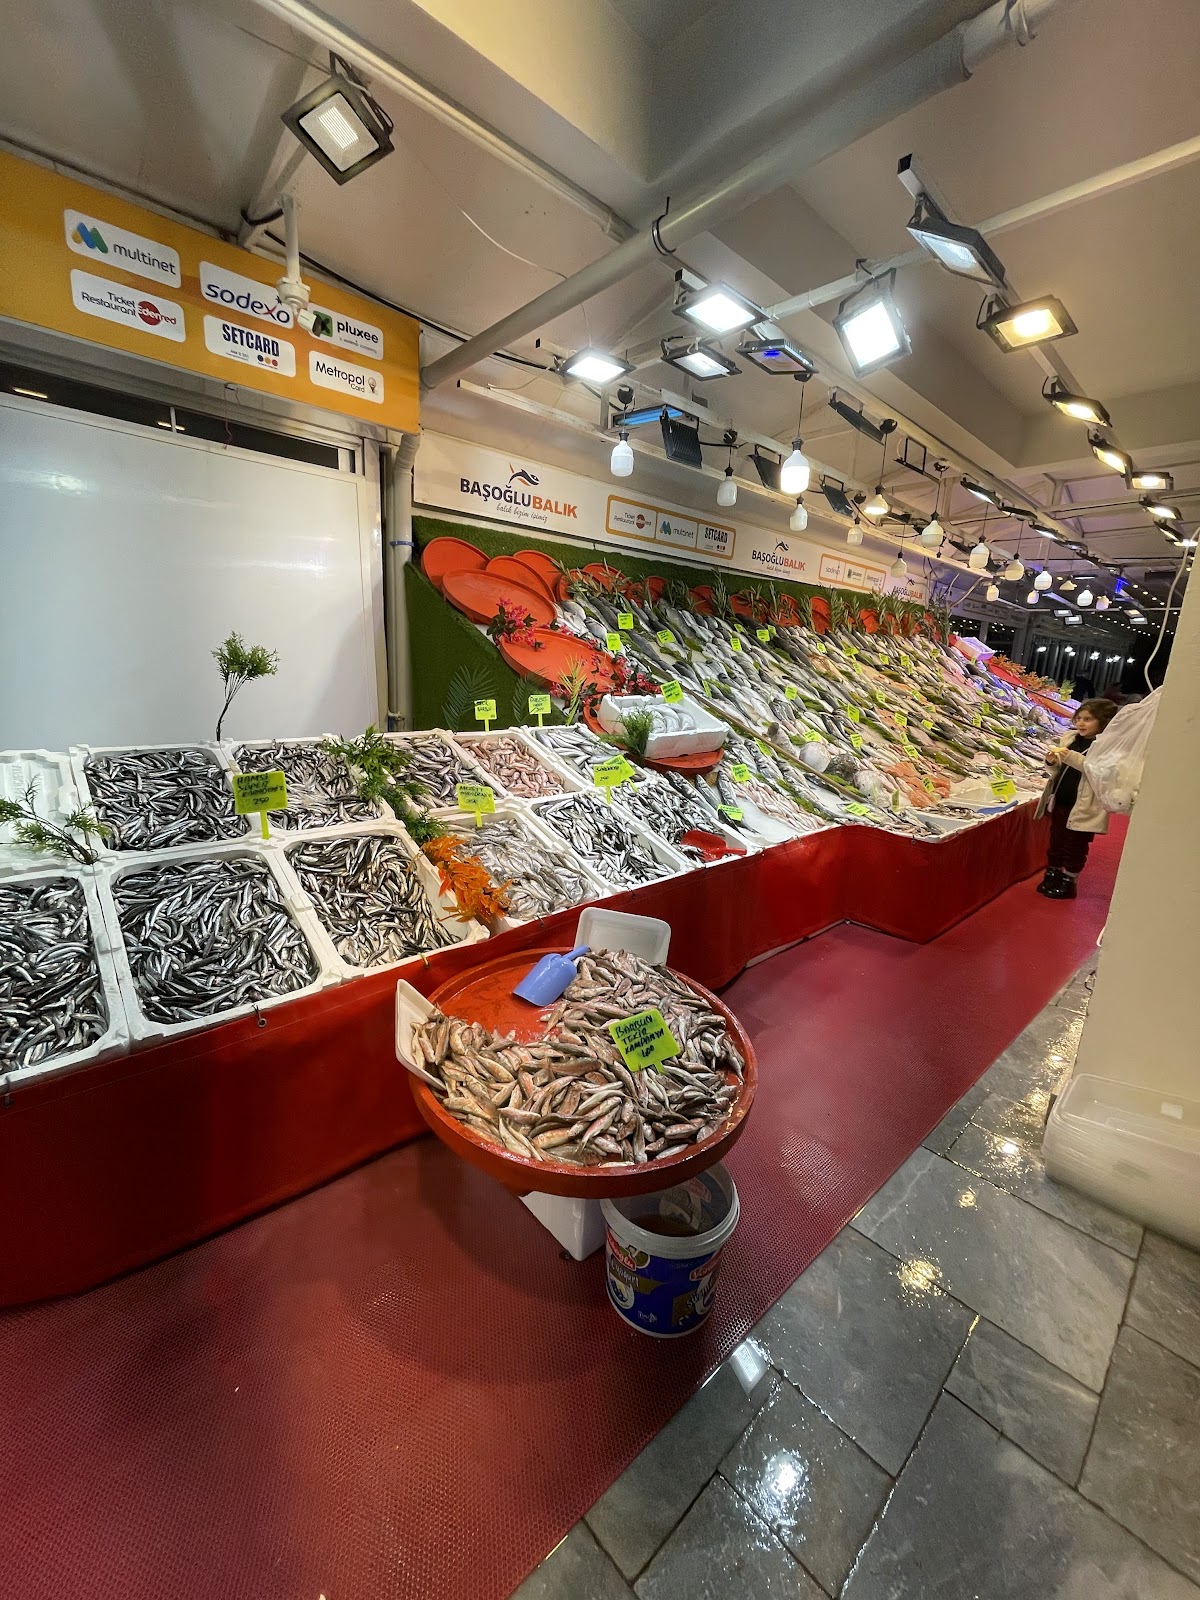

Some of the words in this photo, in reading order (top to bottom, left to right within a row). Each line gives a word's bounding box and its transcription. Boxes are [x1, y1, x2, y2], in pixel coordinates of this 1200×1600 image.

[113, 243, 176, 275] multinet
[81, 291, 137, 317] Restaurant
[107, 291, 136, 308] Ticket
[205, 283, 290, 323] sodexo
[137, 304, 177, 325] Edenred
[222, 323, 280, 357] SETCARD
[337, 321, 379, 344] pluxee
[315, 360, 365, 385] Metropol
[350, 383, 365, 393] Card
[672, 528, 694, 539] multinet
[704, 526, 728, 544] SETCARD
[615, 1015, 653, 1038] BARBUN
[621, 1027, 650, 1046] TEKİR
[625, 1028, 665, 1055] KAMPANYA
